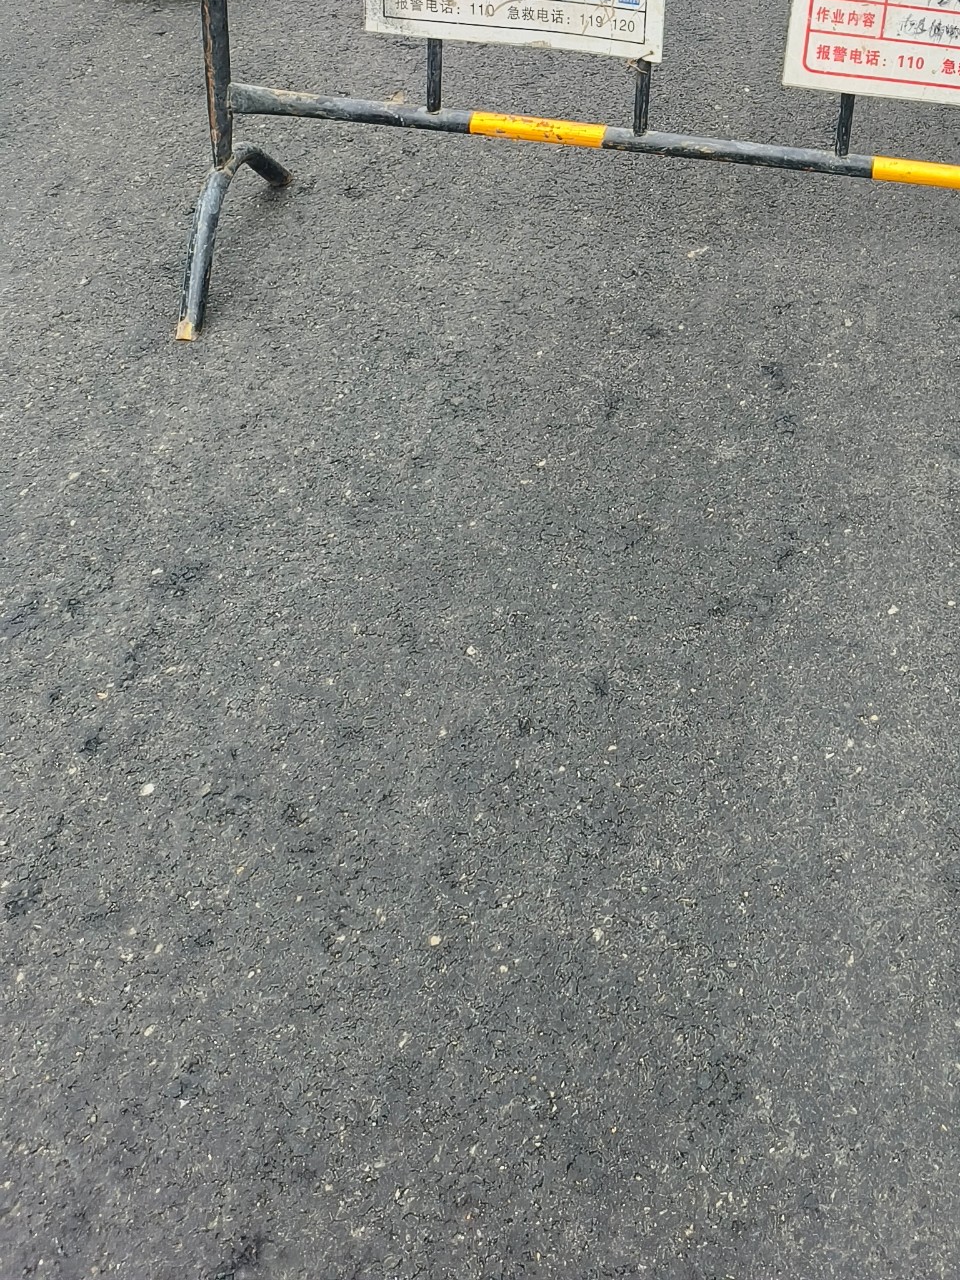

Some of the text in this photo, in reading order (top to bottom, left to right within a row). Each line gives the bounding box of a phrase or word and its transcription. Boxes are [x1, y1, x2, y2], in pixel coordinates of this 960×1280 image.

[612, 19, 636, 33] 120
[816, 6, 877, 28] 作业内容
